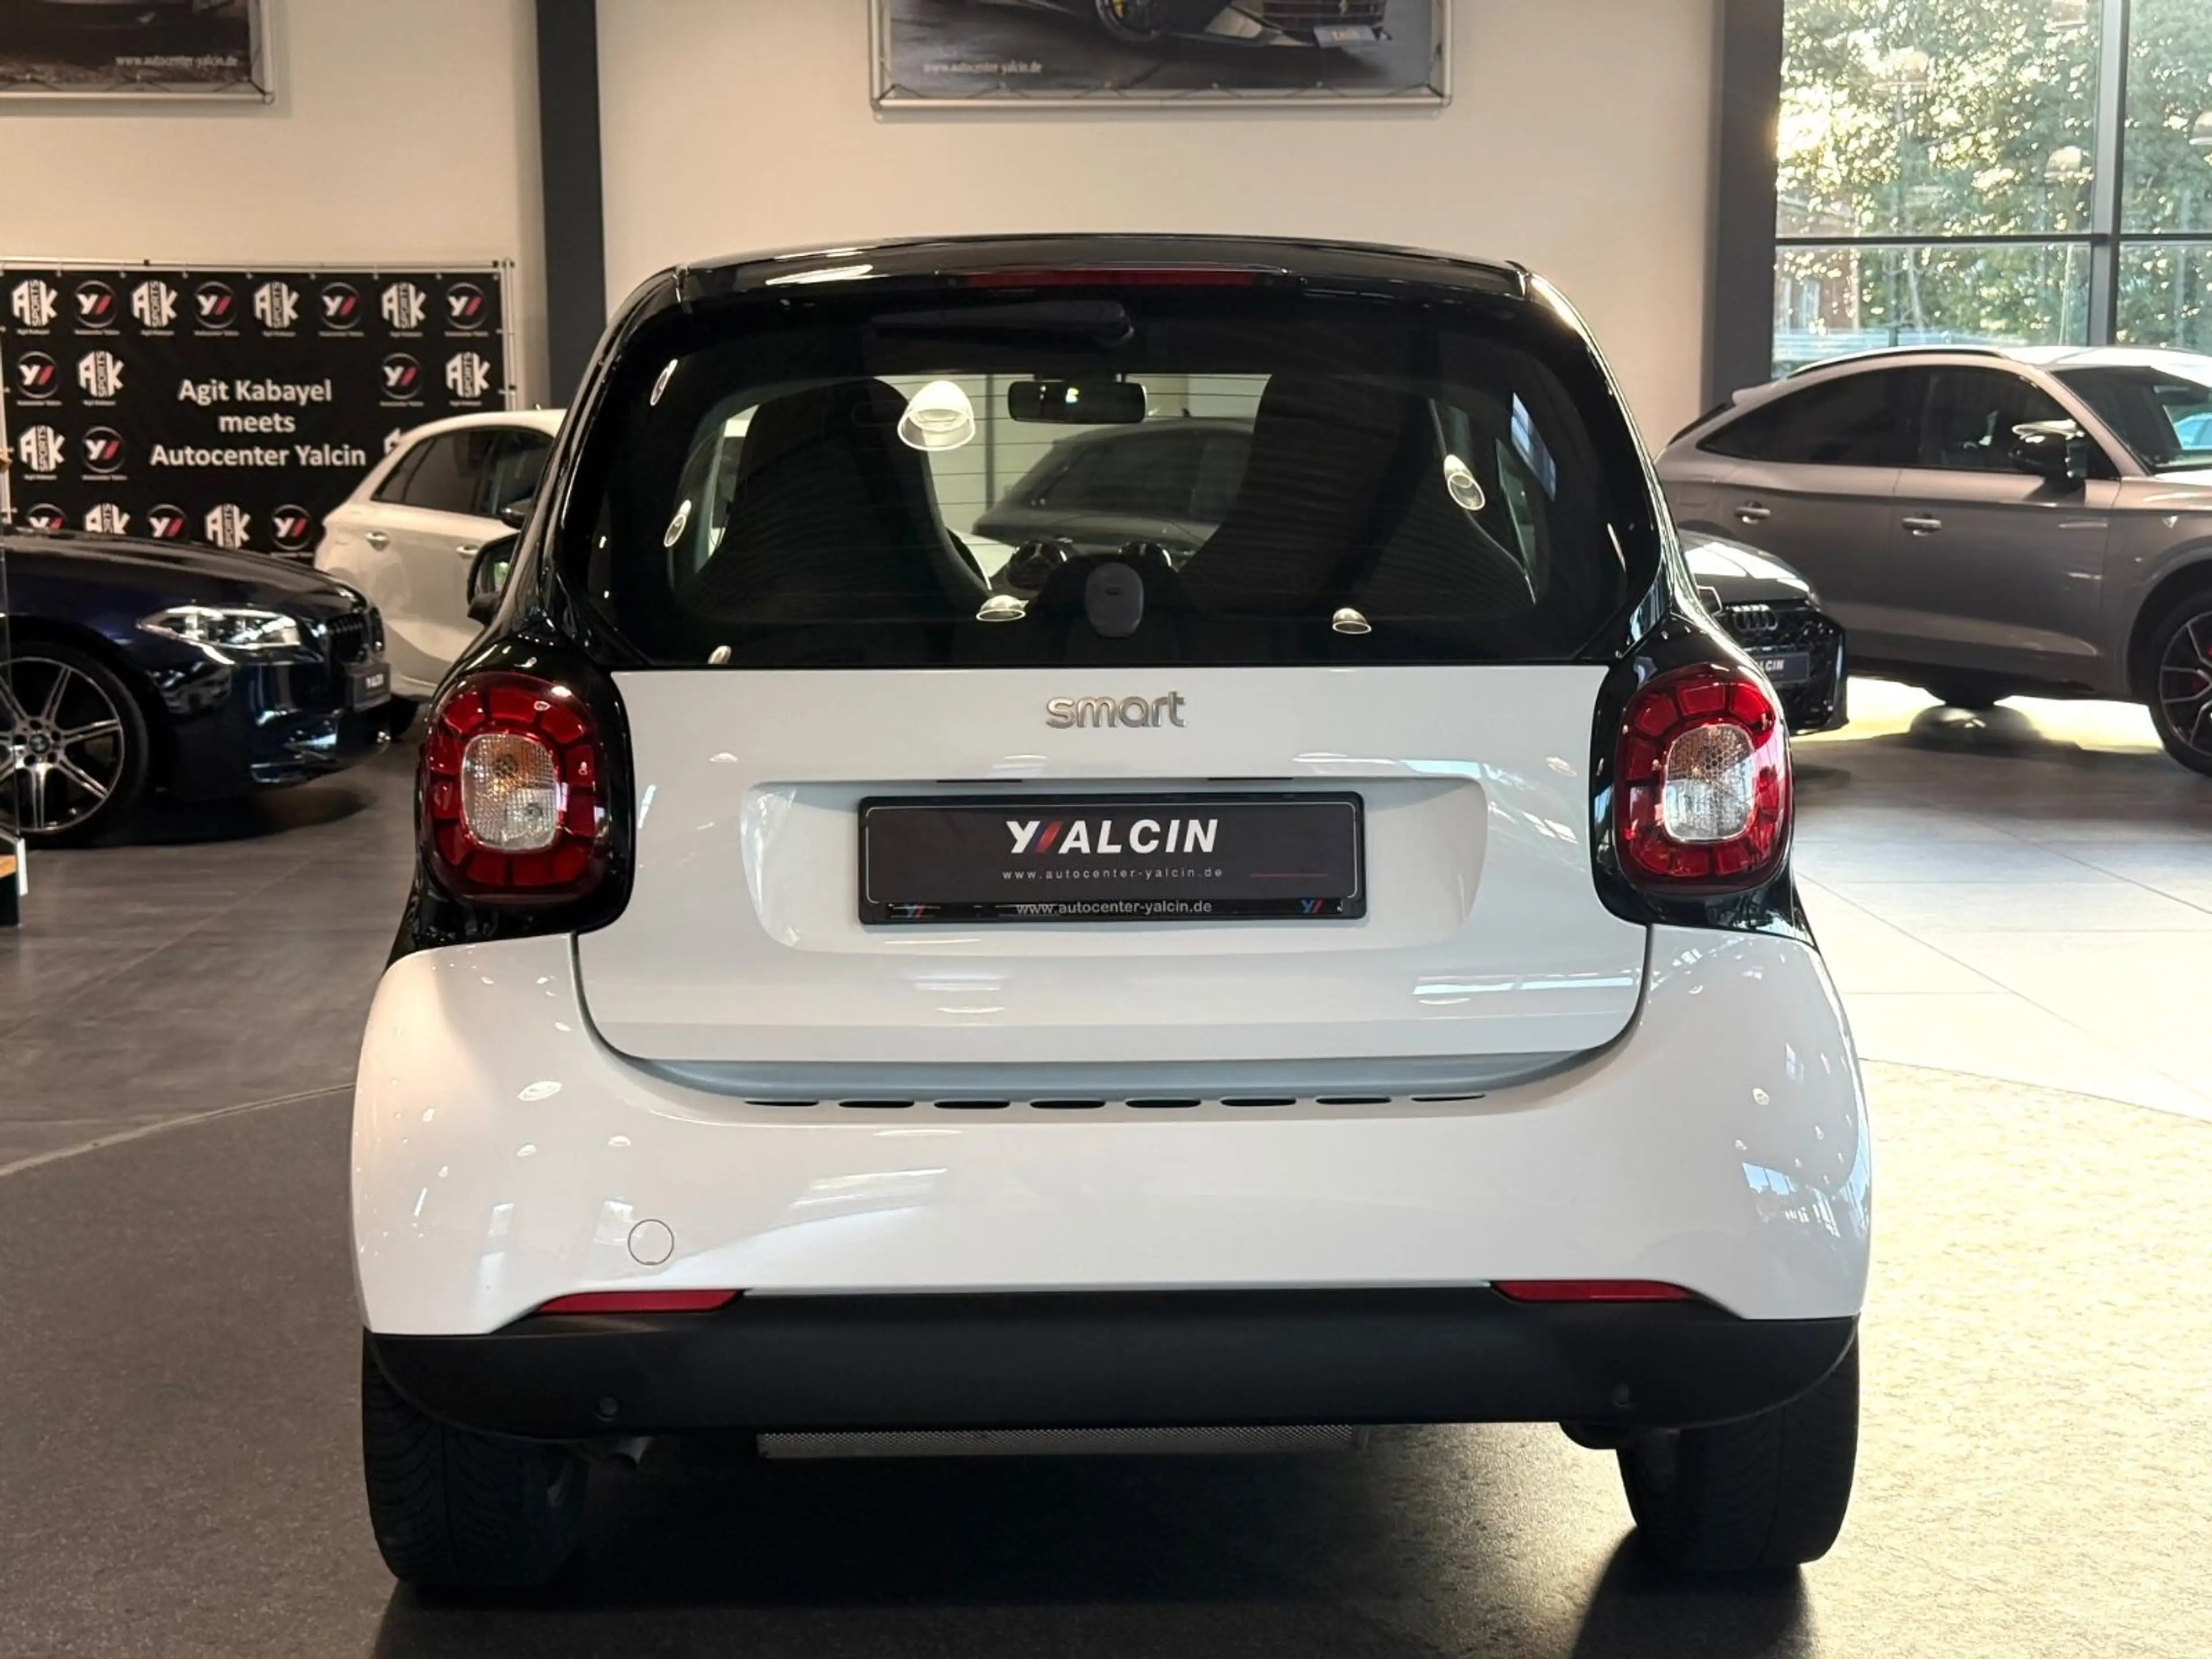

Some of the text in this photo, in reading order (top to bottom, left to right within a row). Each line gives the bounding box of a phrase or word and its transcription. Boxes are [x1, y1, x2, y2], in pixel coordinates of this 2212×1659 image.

[179, 378, 332, 406] Agit Kabayel
[217, 412, 296, 433] meets
[150, 444, 366, 466] Autocenter Yalcin
[1046, 691, 1187, 729] smart
[1002, 868, 1222, 881] www.autocenter-yalcin.de
[1016, 900, 1212, 915] www.autocenter-yalcin.de
